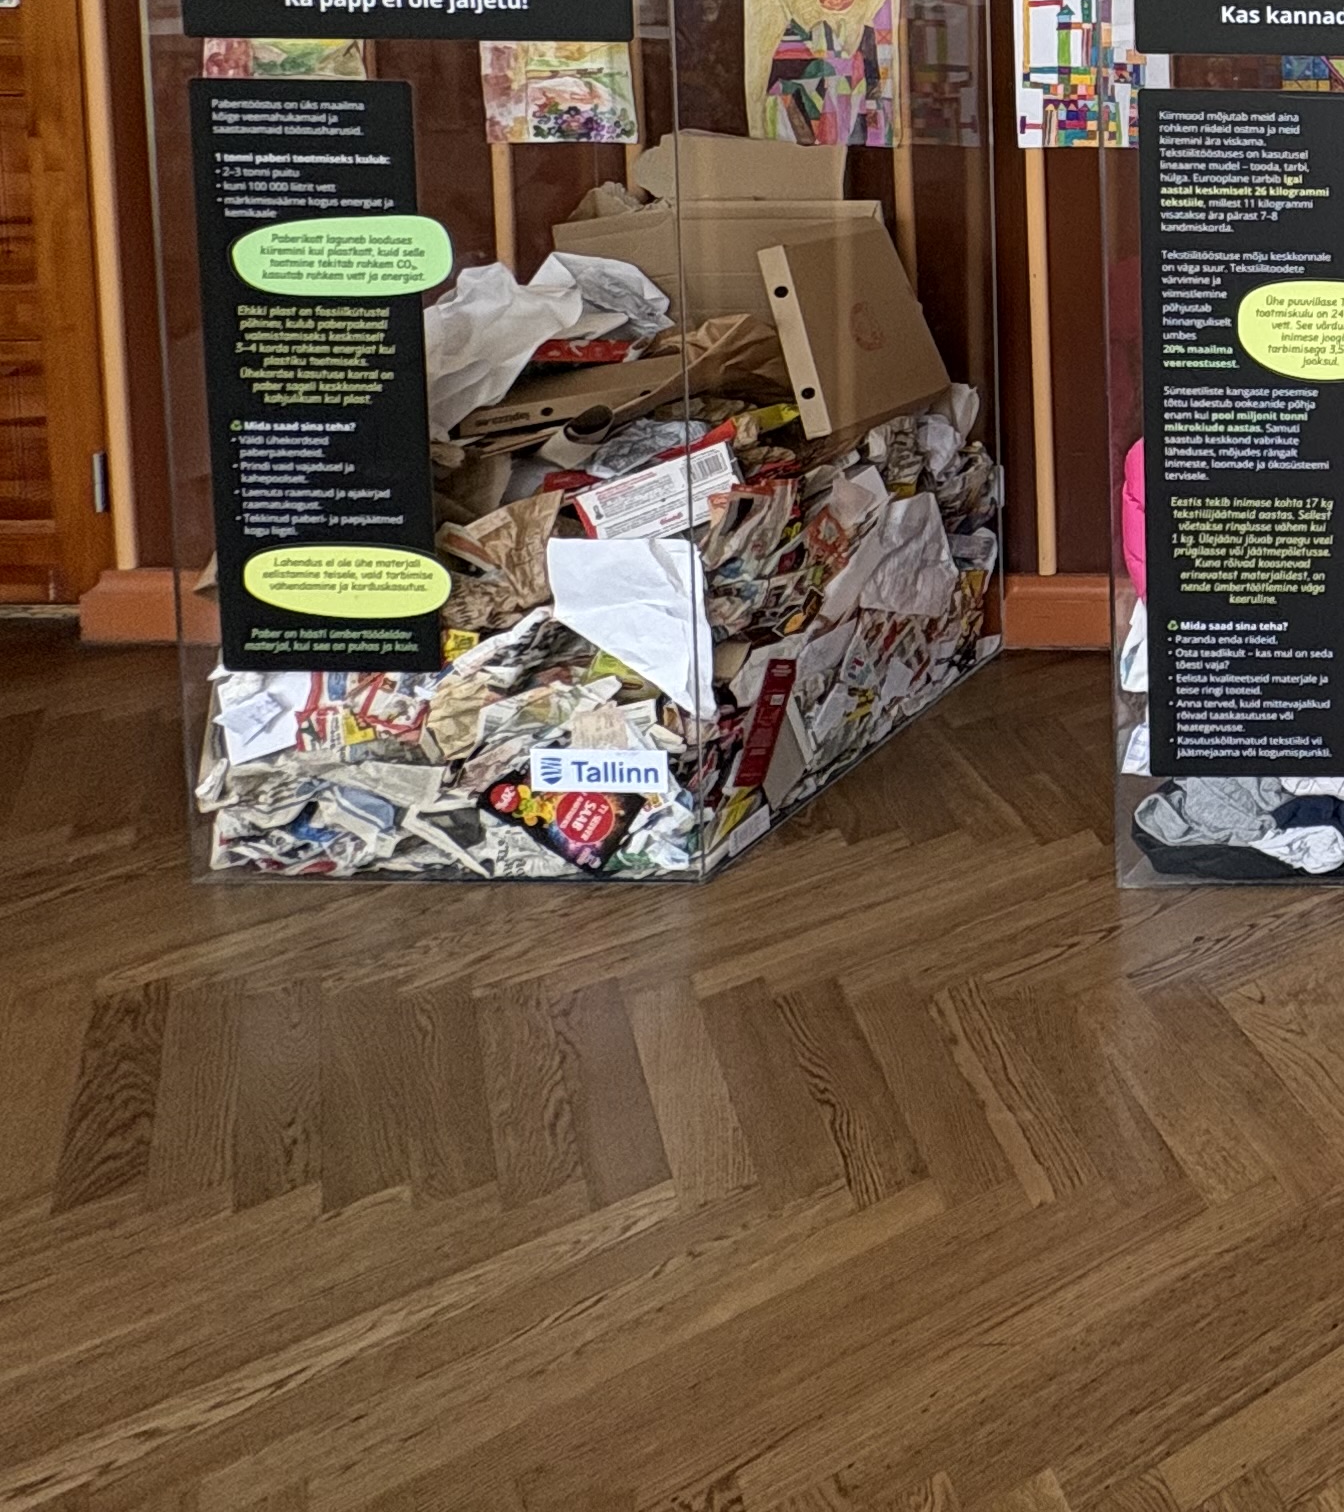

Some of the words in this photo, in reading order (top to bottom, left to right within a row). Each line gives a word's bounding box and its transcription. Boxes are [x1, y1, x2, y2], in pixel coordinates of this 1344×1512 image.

[1222, 6, 1260, 24] Kas
[1207, 112, 1248, 124] mõjutab
[1251, 112, 1275, 121] meid
[1278, 112, 1299, 122] aina
[1159, 124, 1198, 133] rohkem
[1200, 124, 1231, 133] riideid
[1234, 125, 1264, 134] ostma
[1267, 125, 1276, 136] ja
[1279, 125, 1300, 134] neid
[1159, 136, 1202, 145] kiiremini
[1204, 136, 1221, 146] ära
[1160, 173, 1190, 185] hülga.
[1193, 174, 1249, 185] Eurooplane
[1252, 174, 1281, 183] tarbib
[1283, 174, 1302, 185] igal
[1161, 186, 1192, 195] aastal
[1195, 186, 1252, 196] keskmiselt
[1255, 187, 1267, 196] 26
[1269, 187, 1329, 199] kilogrammi
[1208, 199, 1241, 208] millest
[1244, 199, 1255, 208] 11
[1258, 199, 1313, 211] kilogrammi
[1161, 211, 1206, 220] visatakse
[1208, 211, 1224, 221] ära
[1227, 211, 1258, 223] pärast
[1161, 223, 1234, 232] kandmiskorda.
[1266, 295, 1284, 306] Ühe
[1287, 297, 1337, 308] puuvillase
[1256, 309, 1313, 318] tootmiskulu
[1296, 322, 1313, 330] See
[1281, 334, 1319, 342] inimese
[1268, 345, 1326, 356] tarbimisega
[1301, 358, 1339, 368] jooksul.
[244, 421, 271, 430] Mida
[273, 422, 298, 431] saad
[301, 422, 323, 431] sina
[326, 422, 356, 431] teha?
[1170, 498, 1202, 507] Eestis
[1205, 498, 1231, 507] tekib
[1233, 499, 1272, 507] inimese
[1274, 499, 1303, 507] kohta
[1306, 499, 1318, 508] 17
[1321, 499, 1333, 510] kg
[1181, 622, 1206, 630] Mida
[1209, 622, 1233, 631] saad
[1235, 623, 1257, 631] sina
[1259, 623, 1288, 631] teha?
[571, 762, 659, 783] Tallinn
